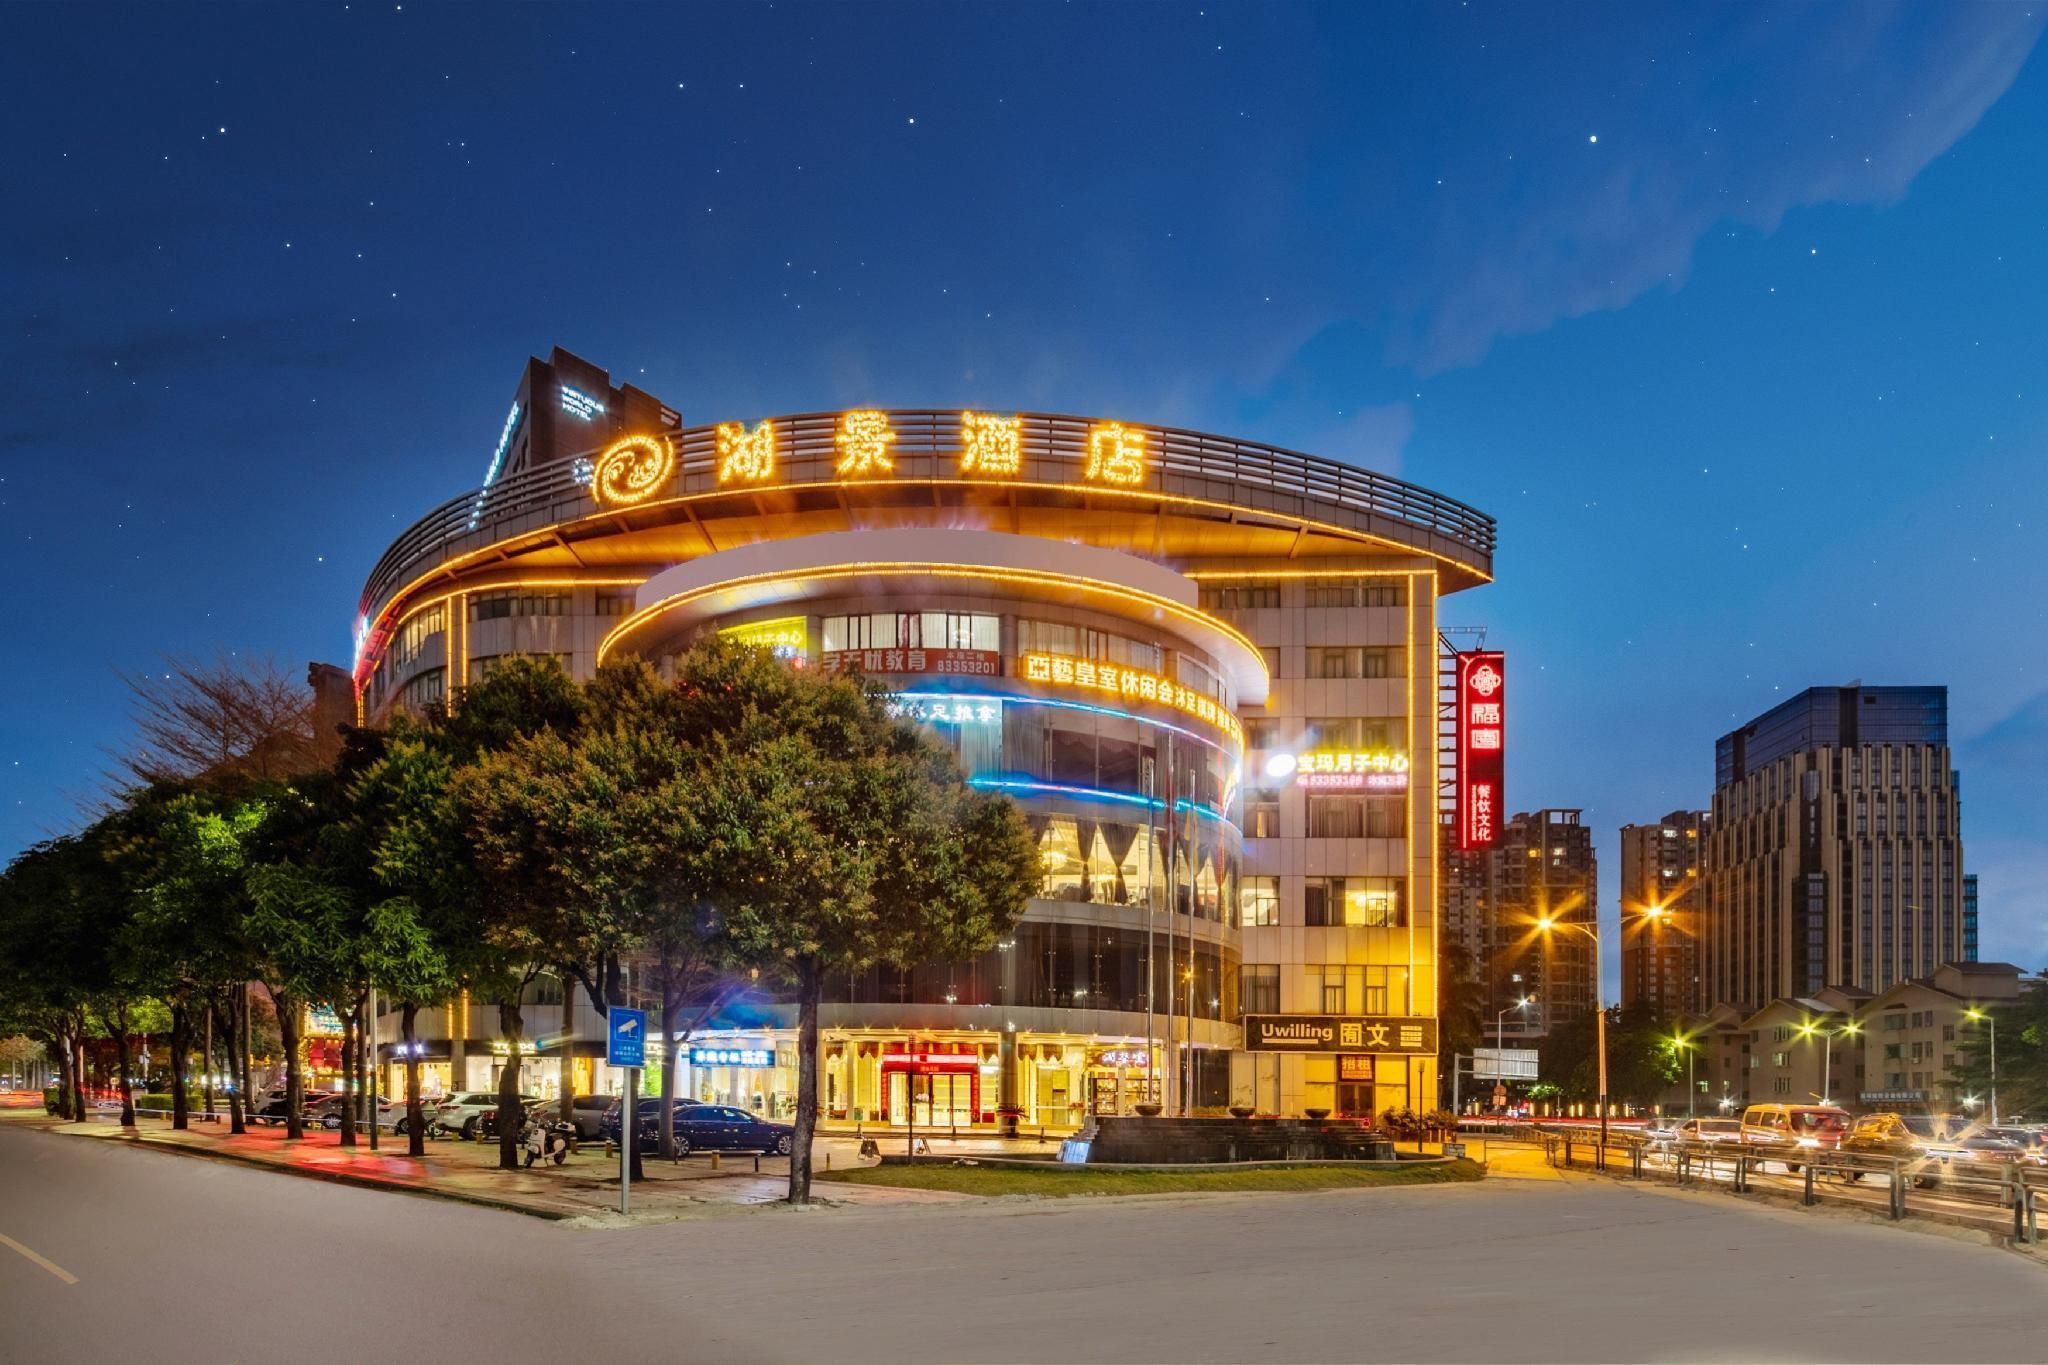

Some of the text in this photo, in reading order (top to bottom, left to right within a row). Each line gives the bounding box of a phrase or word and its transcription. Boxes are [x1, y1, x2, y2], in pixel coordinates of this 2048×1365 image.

[561, 393, 593, 414] WORLD
[562, 402, 592, 421] HOTEL
[718, 409, 1145, 484] 湖景酒店
[1476, 784, 1492, 842] 餐饮文化
[1261, 1023, 1333, 1042] Uwilling
[1341, 1055, 1371, 1071] 招租
